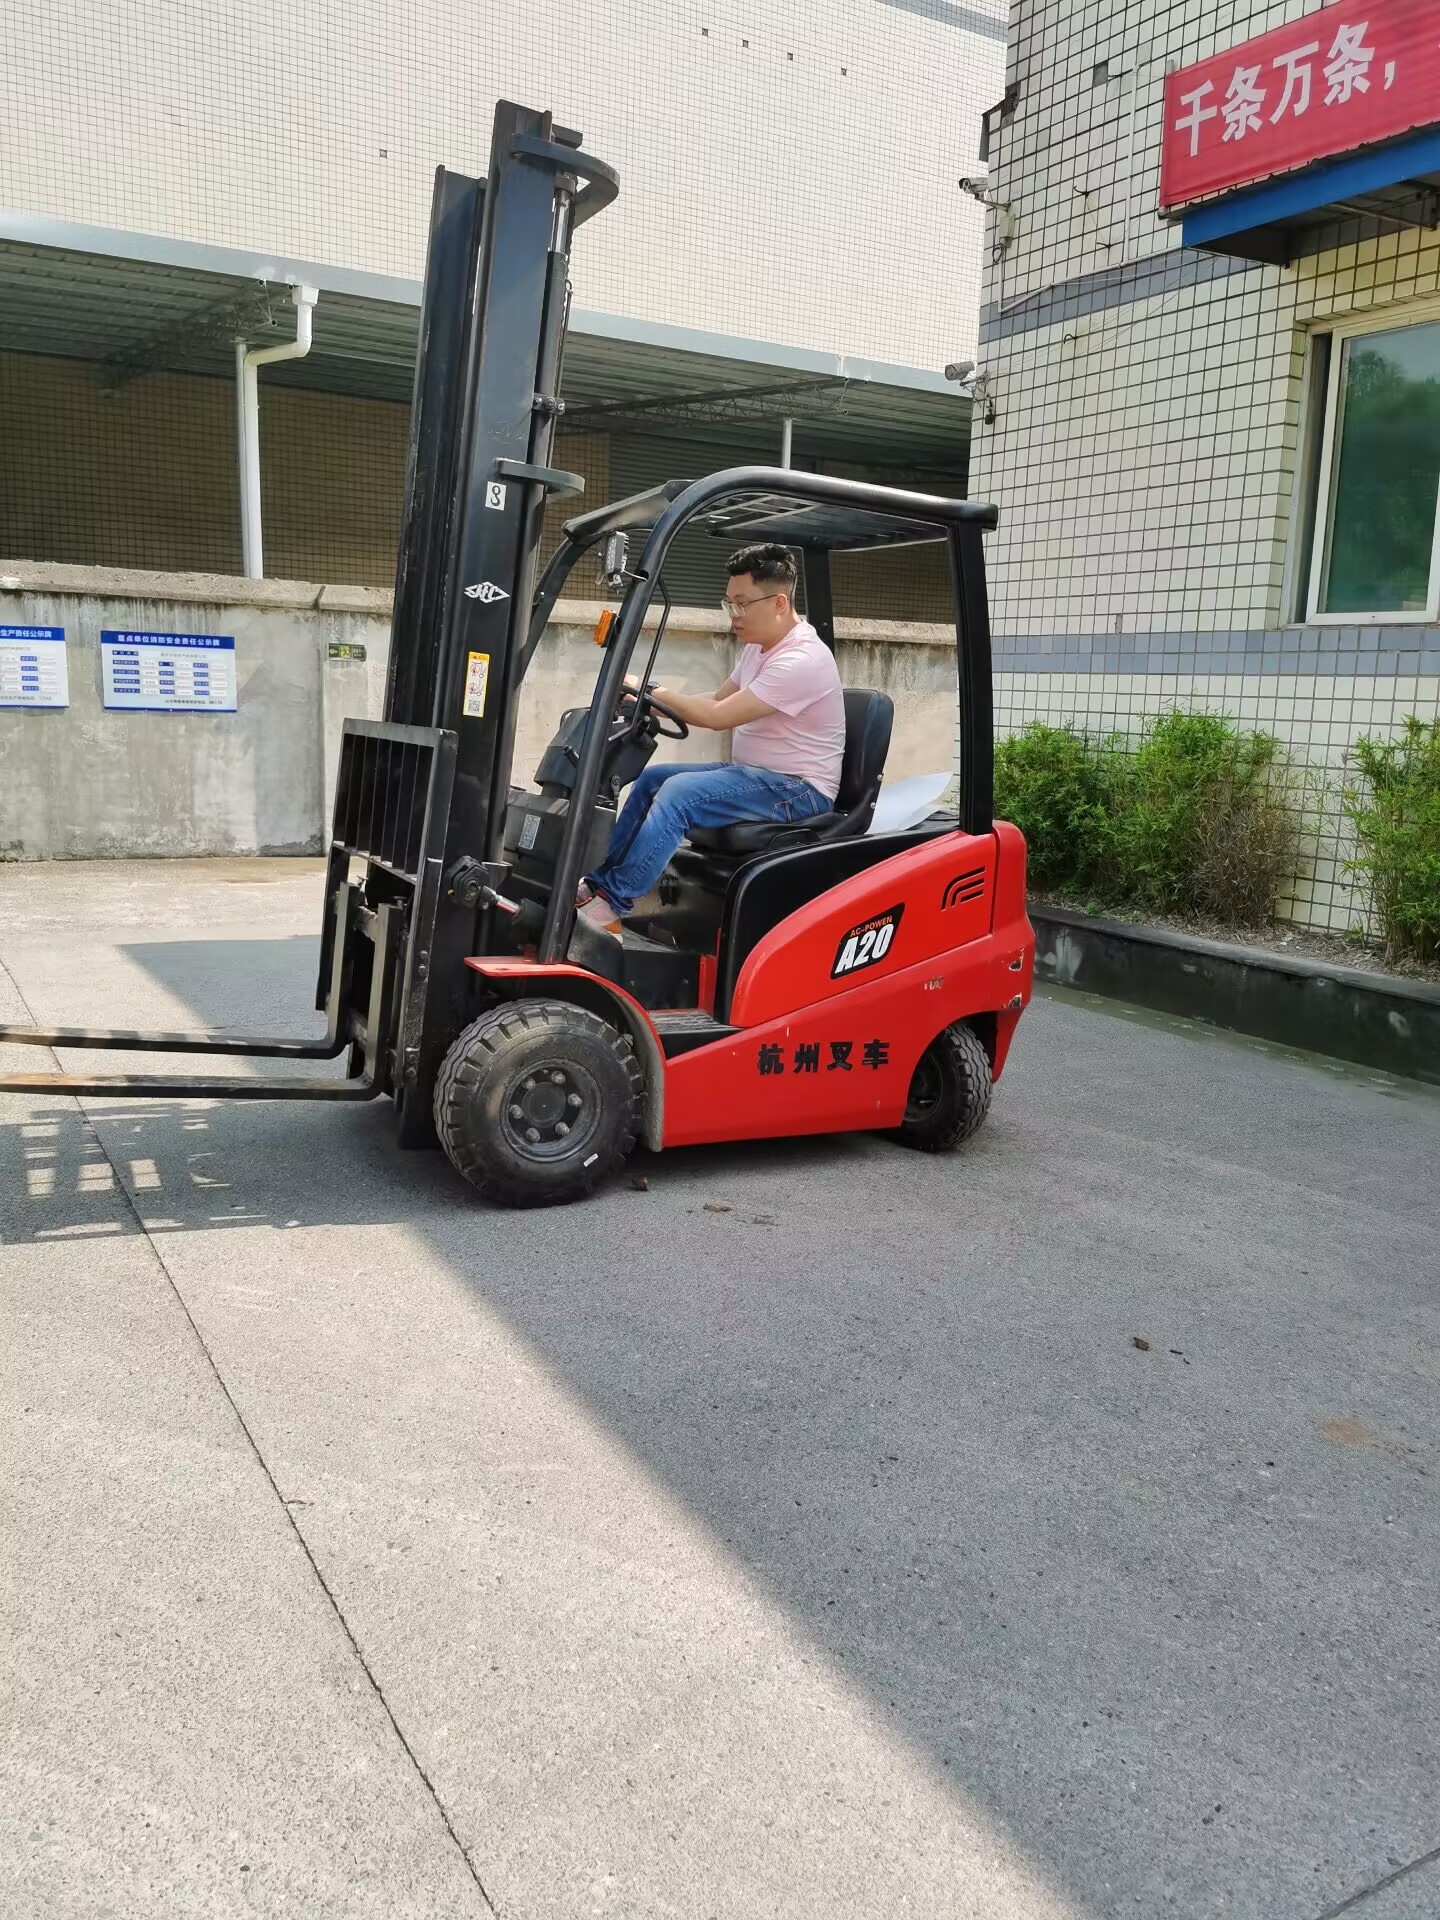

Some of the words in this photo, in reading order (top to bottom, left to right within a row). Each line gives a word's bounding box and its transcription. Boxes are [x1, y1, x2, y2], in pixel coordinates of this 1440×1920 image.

[118, 634, 220, 646] 重点单位消防安全责任公示牌
[834, 923, 895, 974] A20
[758, 1039, 889, 1075] 杭州叉车
